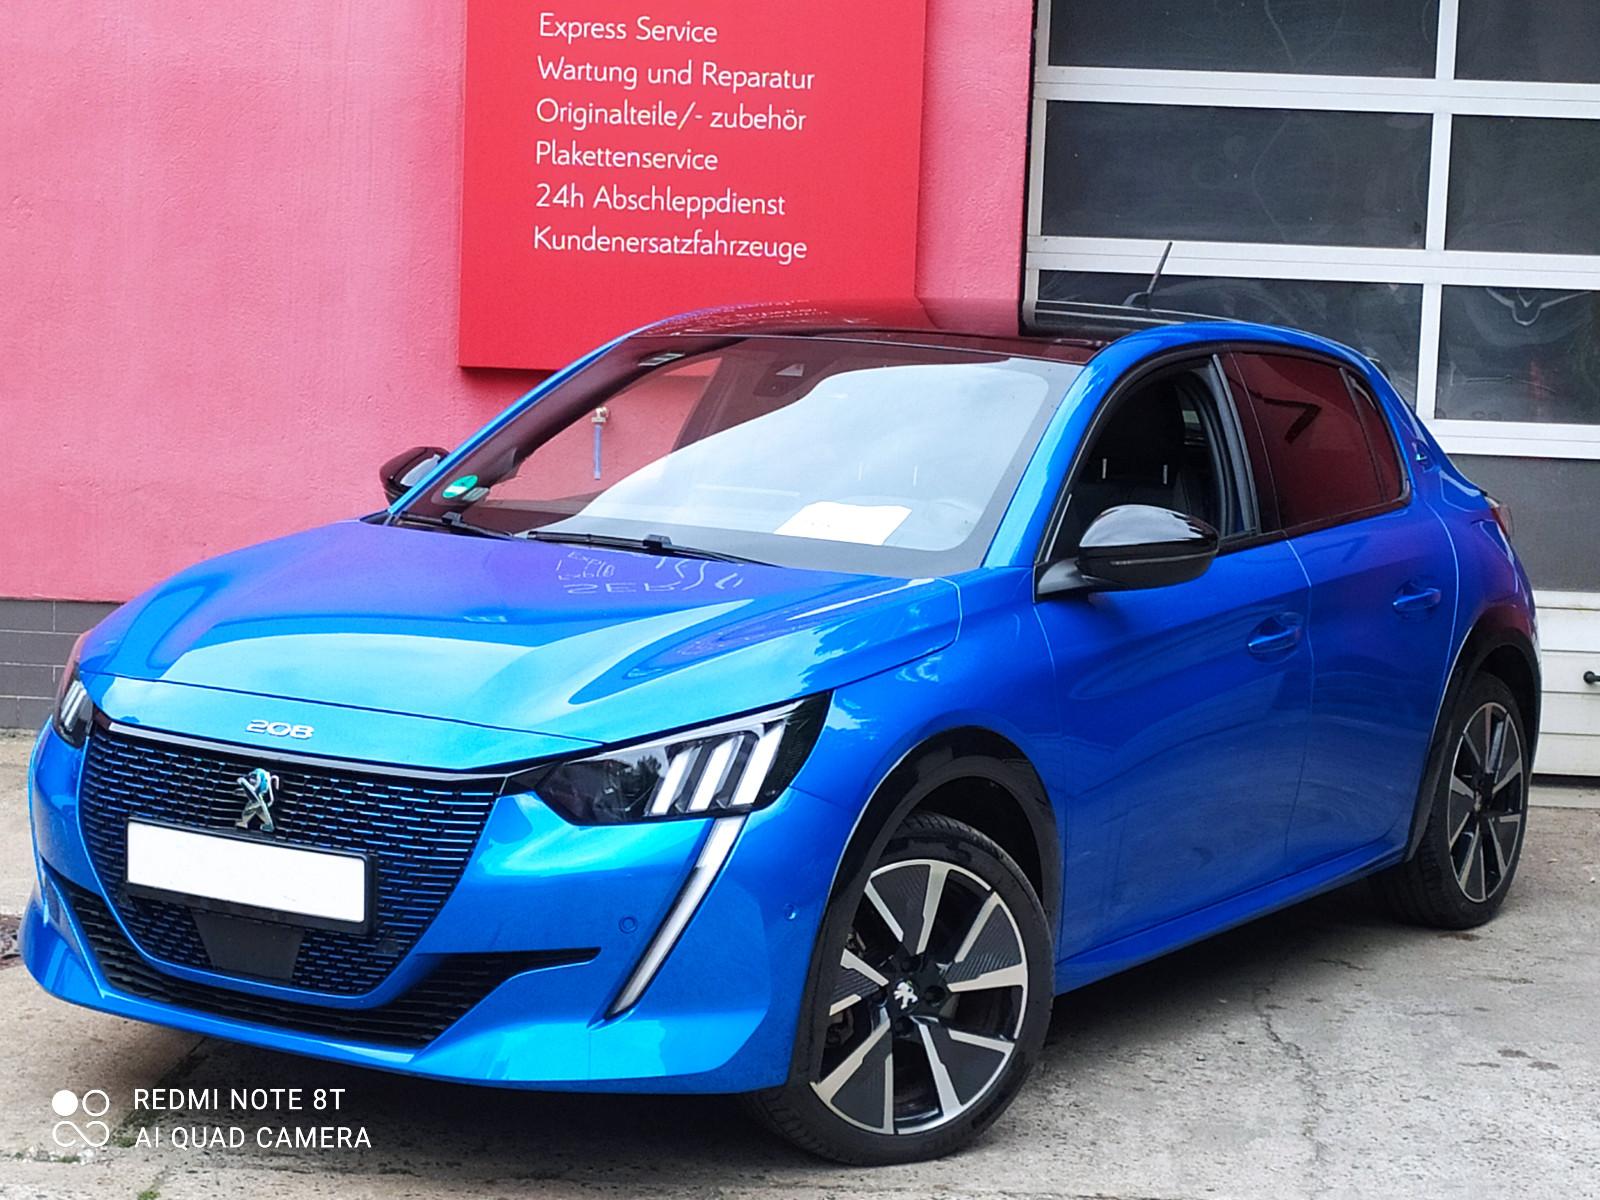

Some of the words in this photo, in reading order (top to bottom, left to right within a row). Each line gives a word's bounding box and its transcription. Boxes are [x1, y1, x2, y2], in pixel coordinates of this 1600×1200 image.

[539, 12, 627, 45] Express
[636, 15, 718, 43] Service
[537, 55, 638, 90] Wartung
[647, 59, 692, 85] und
[702, 61, 815, 94] Reparatur
[709, 102, 807, 131] zubehör
[536, 139, 718, 171] Plakettenservice
[536, 182, 584, 209] 24h
[593, 184, 785, 219] Abschleppdienst
[534, 225, 807, 265] Kundenersatzfahrzeuge
[246, 719, 314, 740] 208
